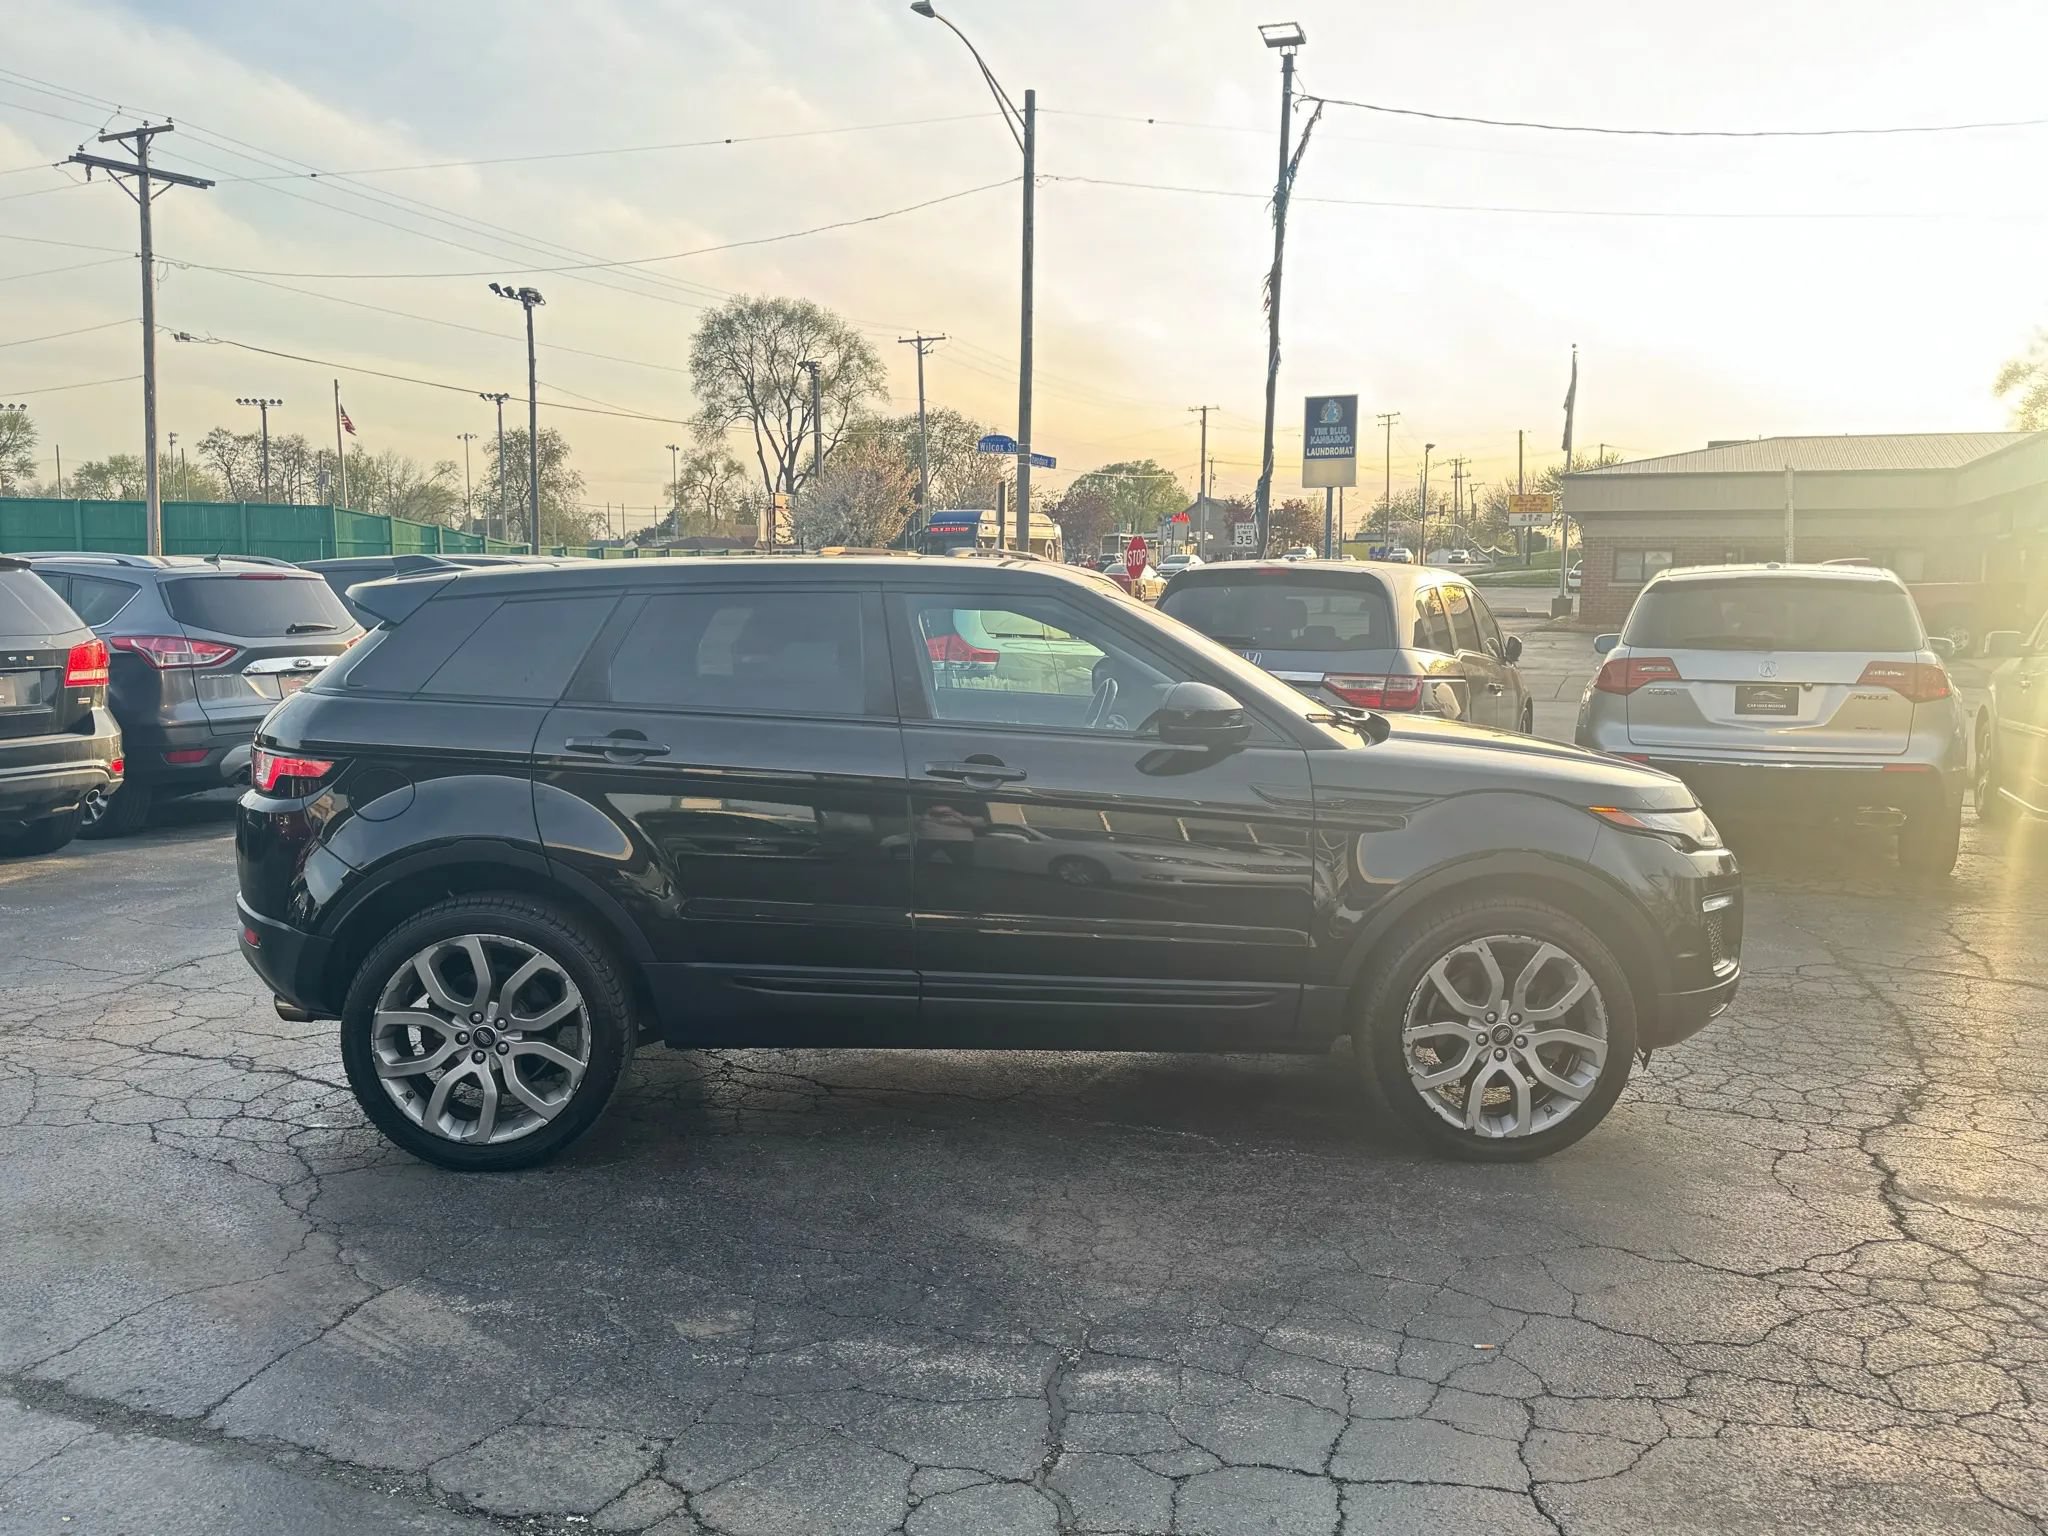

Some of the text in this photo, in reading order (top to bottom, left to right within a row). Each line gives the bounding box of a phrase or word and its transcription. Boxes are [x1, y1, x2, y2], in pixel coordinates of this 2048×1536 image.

[1330, 427, 1347, 435] BLUE
[1311, 435, 1350, 444] KANGAROO
[980, 442, 1016, 452] Wilcox St
[1307, 447, 1353, 456] LAUNDROMAT
[1236, 535, 1253, 545] 35
[1128, 548, 1146, 567] STOP
